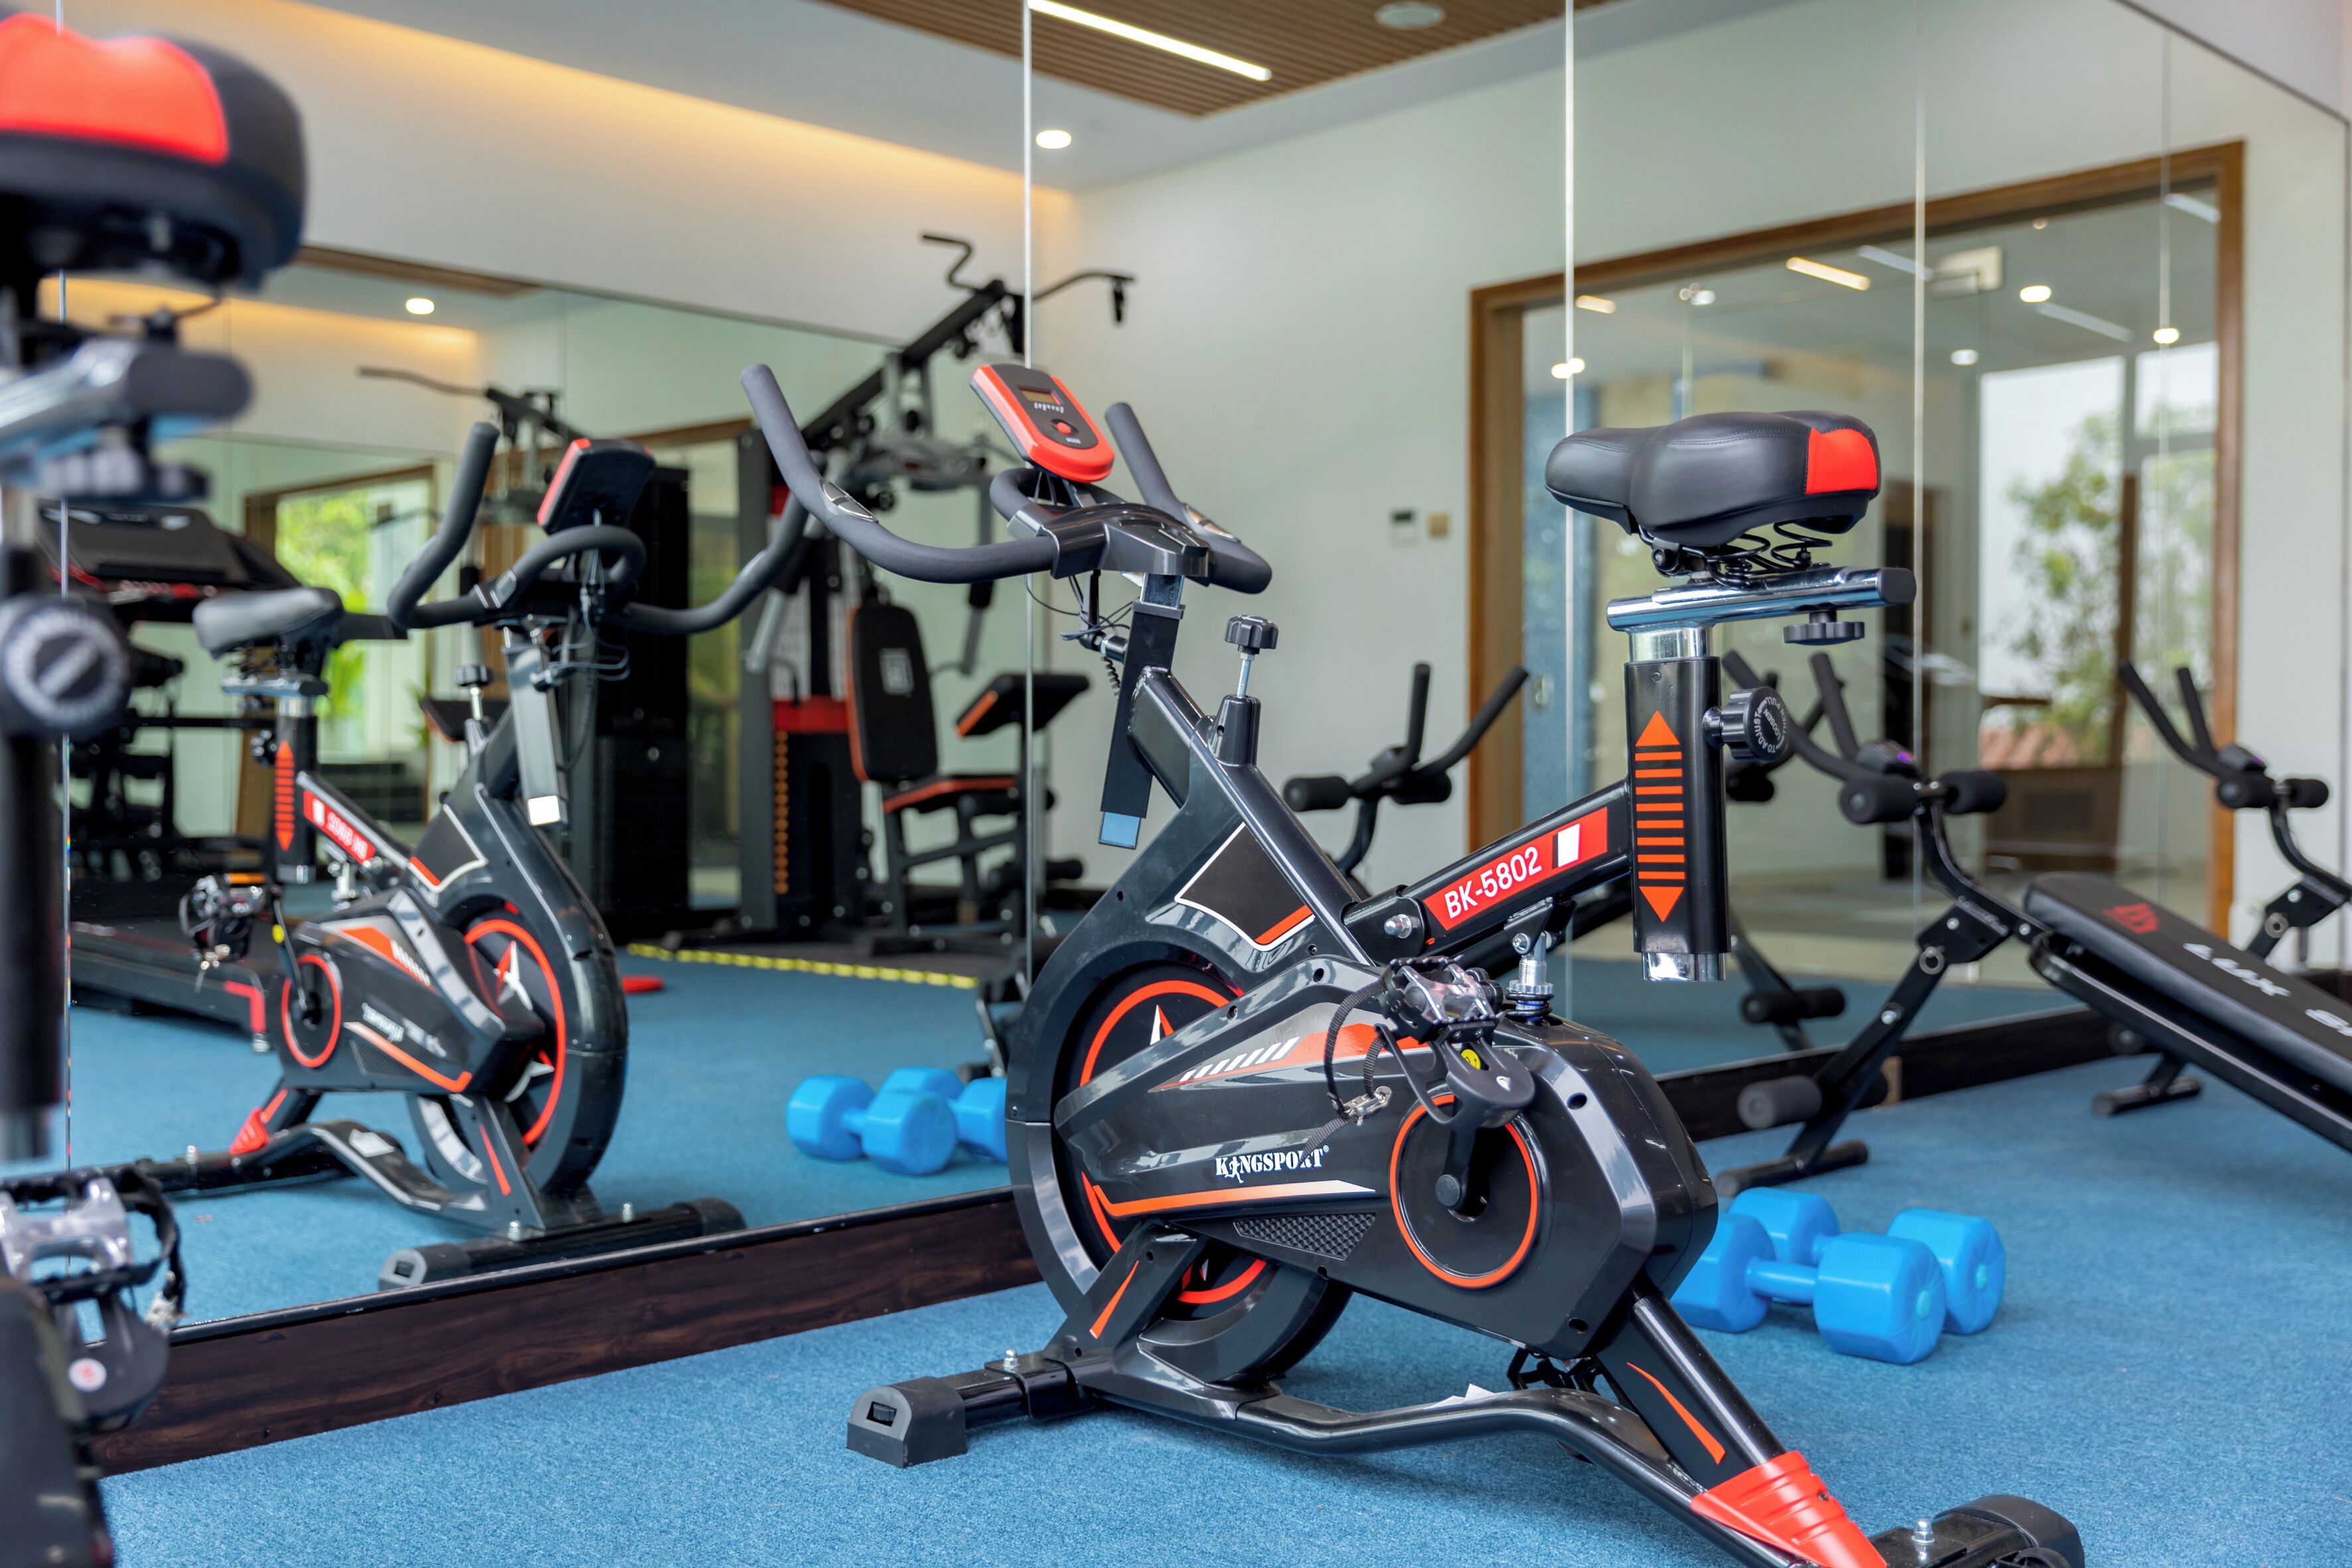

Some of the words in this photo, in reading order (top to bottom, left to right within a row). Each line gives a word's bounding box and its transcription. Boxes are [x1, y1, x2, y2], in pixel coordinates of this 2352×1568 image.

[1765, 696, 1780, 709] PULL
[1754, 711, 1768, 749] ADJUST
[1763, 708, 1781, 740] LOOSEN
[1767, 744, 1776, 753] TO
[1444, 846, 1542, 919] BK-5802
